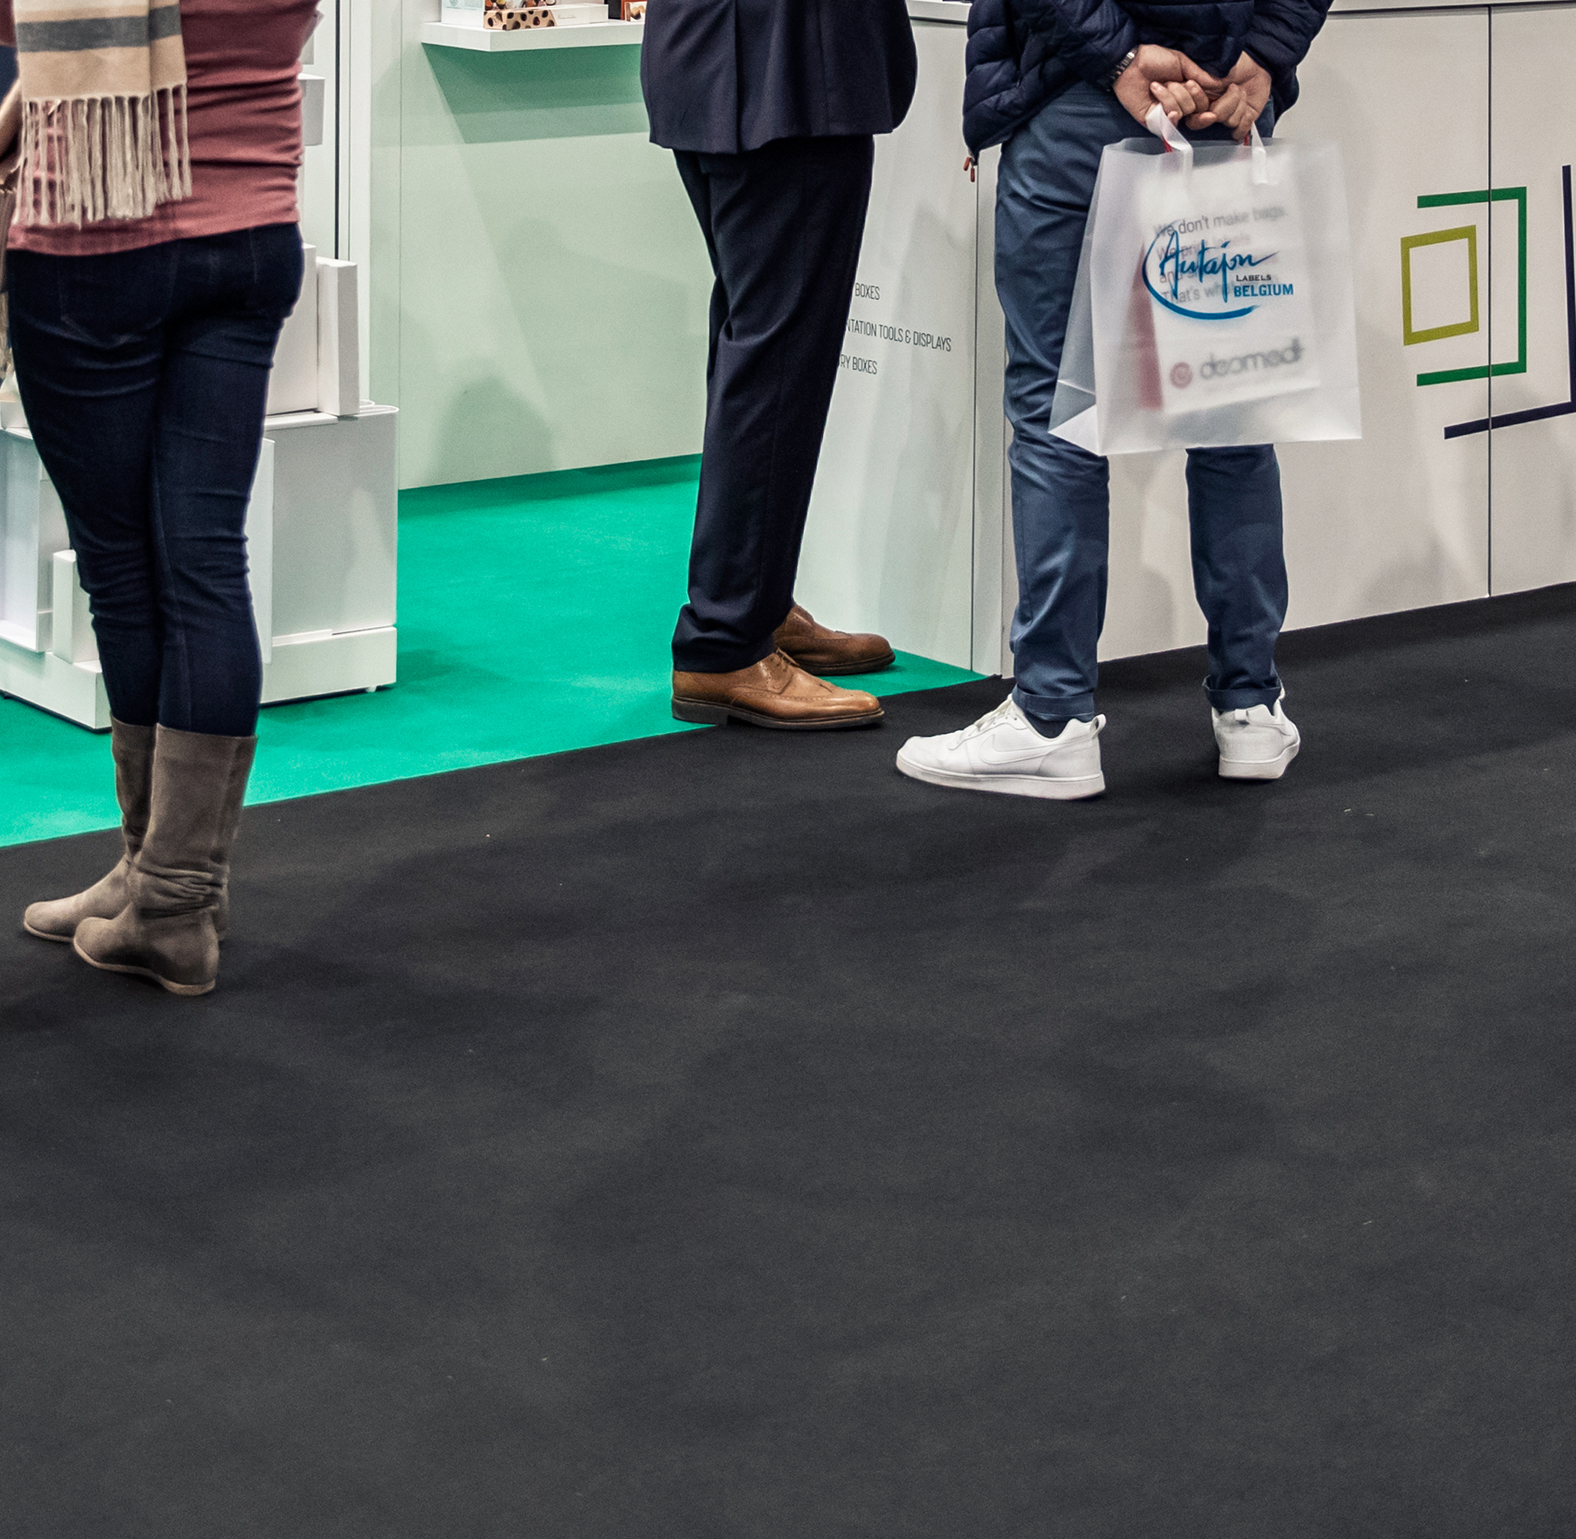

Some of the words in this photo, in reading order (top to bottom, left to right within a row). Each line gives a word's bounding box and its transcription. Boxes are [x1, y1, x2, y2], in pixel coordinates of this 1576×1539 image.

[1178, 215, 1209, 234] don't
[1235, 274, 1272, 282] LABELS
[854, 282, 881, 300] BOXES
[1233, 283, 1294, 297] BELGIUM
[879, 324, 904, 343] TOOLS
[905, 329, 912, 344] &
[913, 331, 952, 352] DISPLAYS
[852, 356, 878, 375] BOXES
